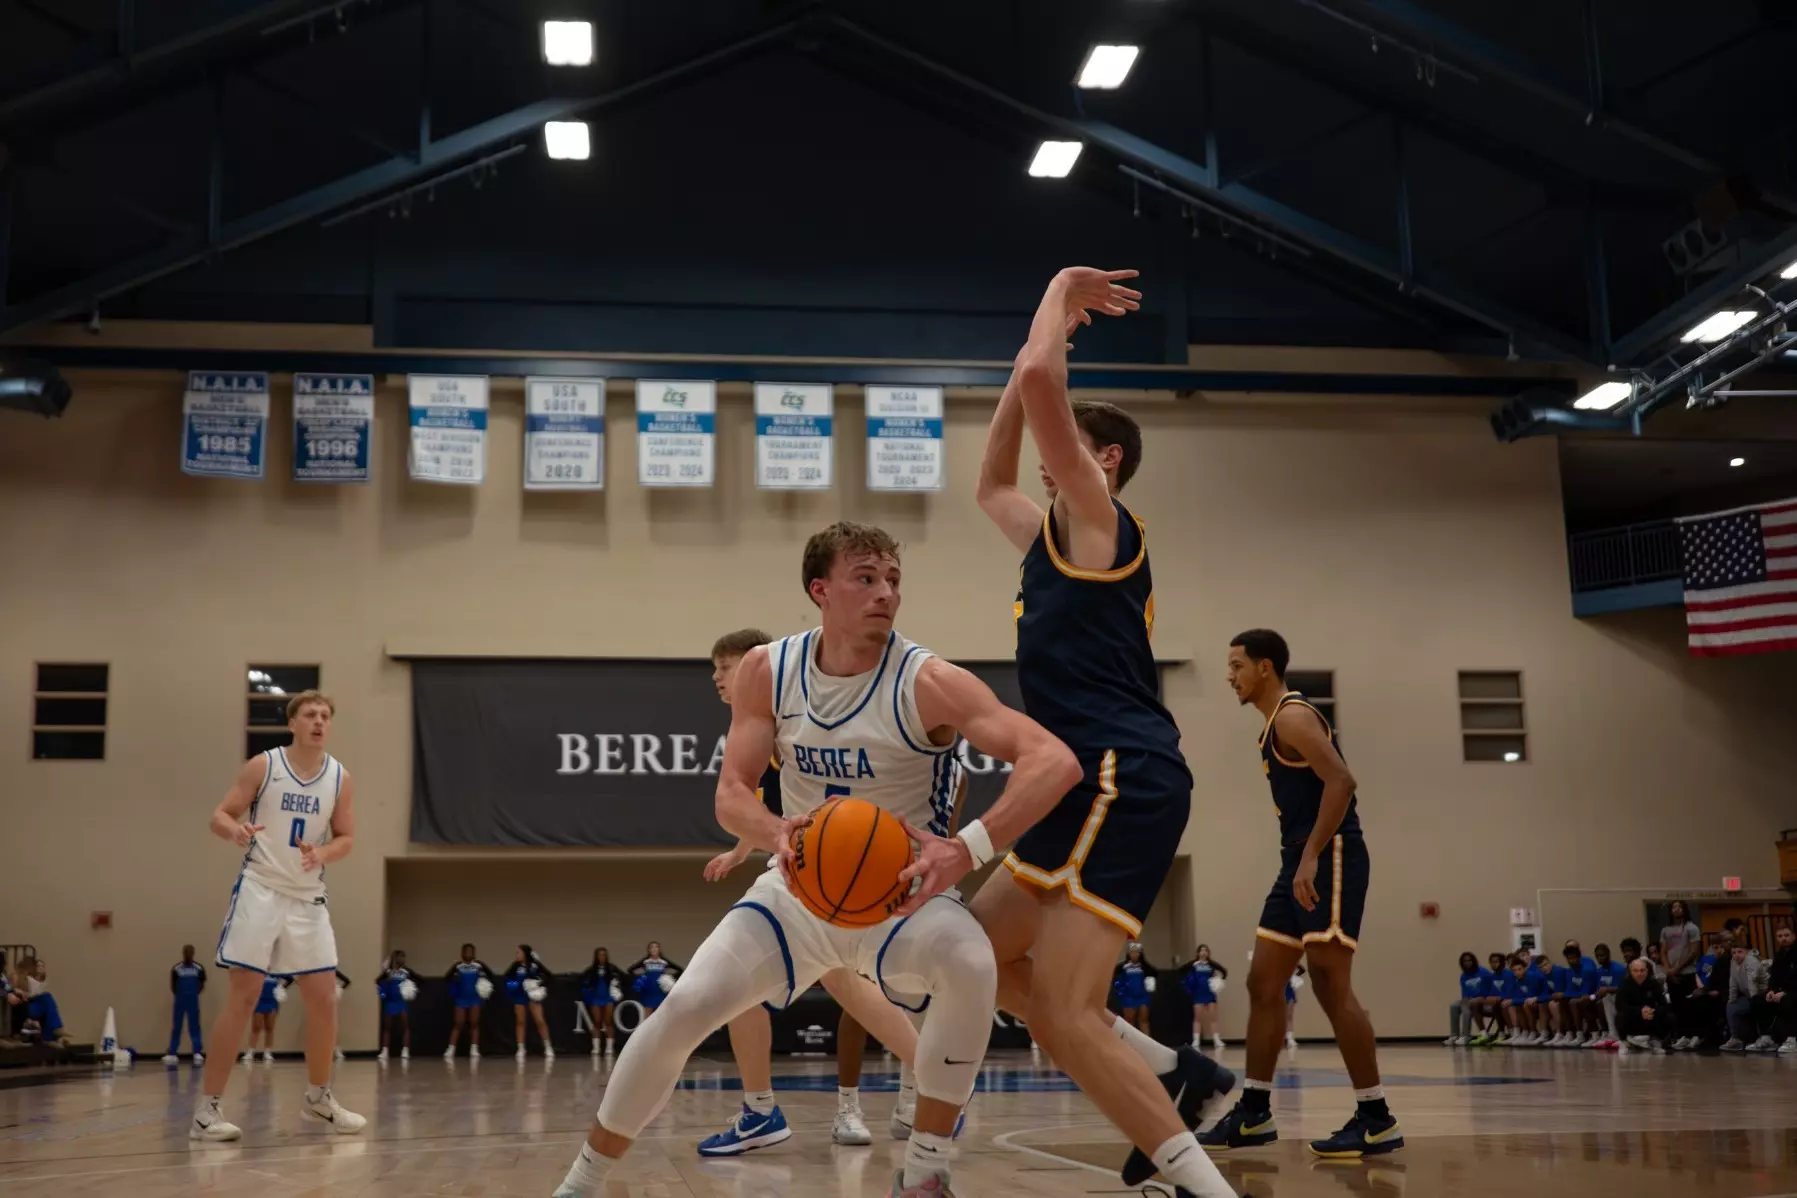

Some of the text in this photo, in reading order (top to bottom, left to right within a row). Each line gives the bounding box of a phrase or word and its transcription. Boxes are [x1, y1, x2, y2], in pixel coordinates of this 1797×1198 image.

[192, 375, 263, 392] N.A.I.A.
[297, 377, 369, 394] N.A.I.A.
[552, 384, 578, 398] USA
[543, 398, 586, 411] SOUTH
[199, 434, 252, 453] 1985
[306, 440, 358, 457] 1996
[545, 464, 583, 478] 2020
[556, 732, 727, 776] BEREA
[792, 743, 876, 779] BEREA
[280, 792, 320, 815] BEREA
[288, 817, 306, 848] 0
